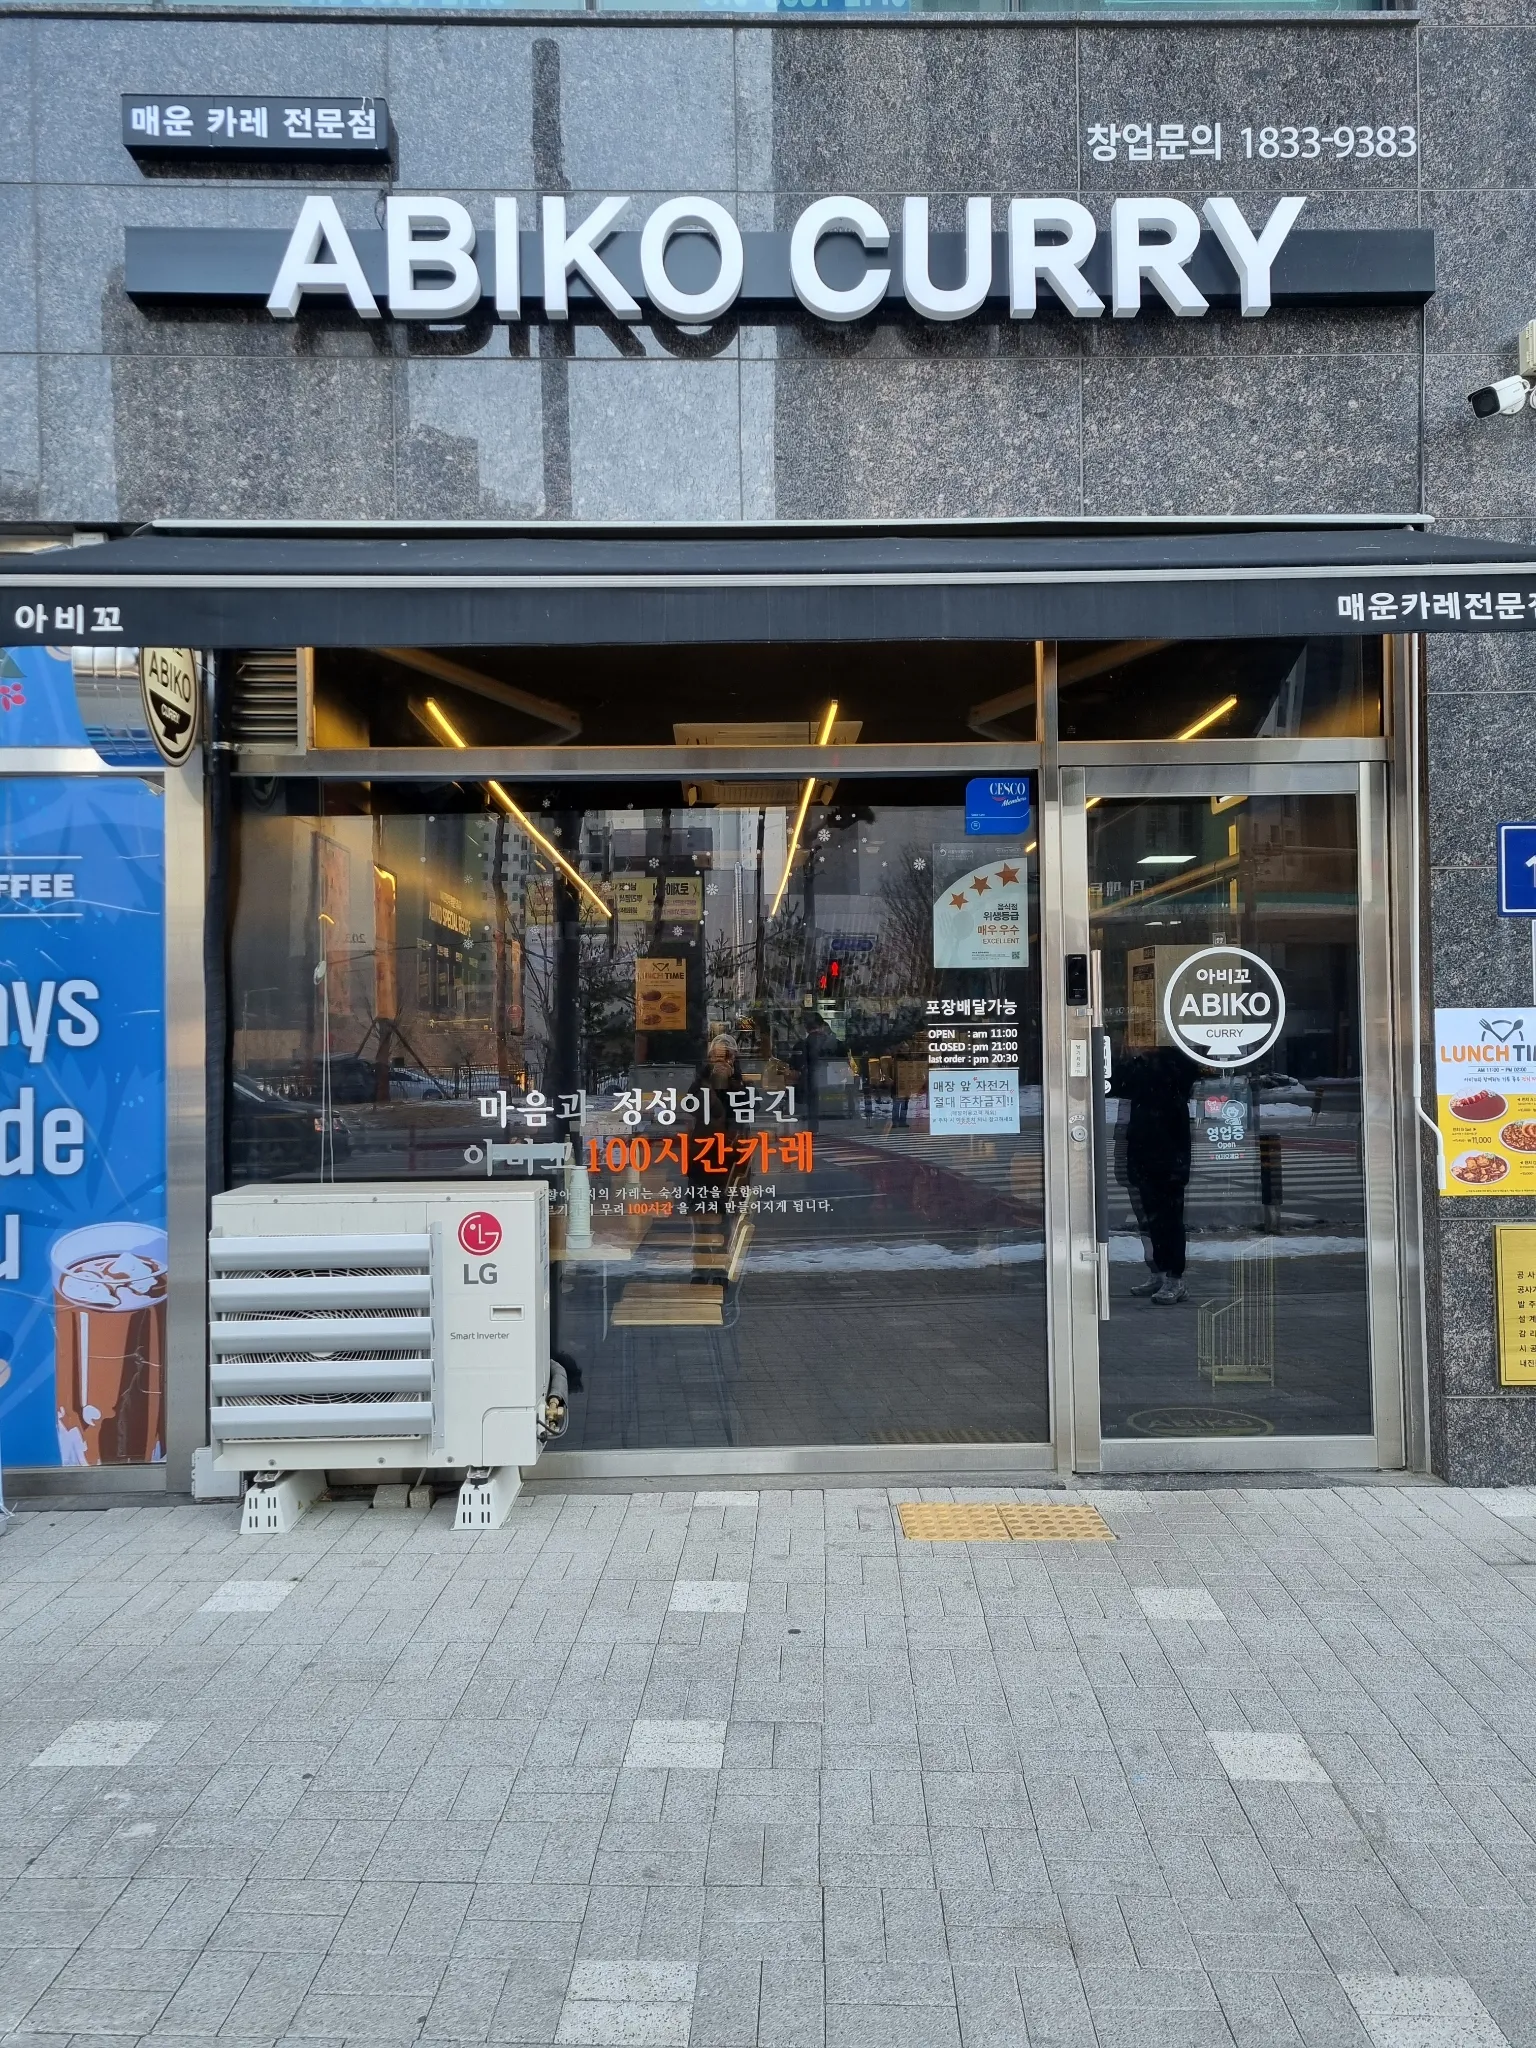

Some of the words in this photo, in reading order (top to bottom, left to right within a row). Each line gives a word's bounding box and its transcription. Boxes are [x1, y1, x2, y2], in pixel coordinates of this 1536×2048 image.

[131, 105, 194, 137] 매운
[207, 106, 268, 138] 카레
[283, 107, 376, 140] 전문점
[1086, 122, 1221, 161] 창업문의
[1240, 125, 1417, 159] 1833-9383
[265, 194, 745, 325] ABIKO
[789, 194, 1307, 322] CURRY
[14, 603, 124, 635] 아비꼬
[149, 650, 192, 703] ABIKO
[989, 782, 1026, 795] CESCO
[983, 911, 1020, 921] 위생등급
[977, 924, 998, 936] 매우
[999, 924, 1020, 936] 우수
[664, 972, 685, 980] TIME
[1196, 968, 1252, 985] 아비꼬
[925, 998, 1018, 1016] 포장배달가능
[1179, 991, 1271, 1017] ABIKO
[0, 979, 100, 1063] ys
[928, 1029, 956, 1039] OPEN
[990, 1028, 1018, 1038] 11:00
[1206, 1028, 1244, 1038] CURRY
[928, 1042, 966, 1052] CLOSED
[972, 1044, 989, 1053] pm
[991, 1041, 1018, 1051] 21:00
[1440, 1044, 1510, 1063] LUNCH
[1512, 1044, 1536, 1062] TI
[928, 1054, 943, 1064] last
[943, 1054, 966, 1063] order
[973, 1056, 989, 1066] pm
[991, 1053, 1019, 1063] 20:30
[933, 1080, 955, 1092] 매장
[960, 1080, 971, 1092] 앞
[976, 1079, 1009, 1092] 자전거
[477, 1089, 595, 1129] 마음과
[611, 1087, 711, 1126] 정성이
[726, 1086, 799, 1124] 담긴
[933, 1096, 956, 1109] 절대
[1207, 1125, 1245, 1142] 영업중
[586, 1130, 814, 1175] 100시간카레
[1217, 1141, 1237, 1149] Open
[615, 1187, 653, 1200] 카레는
[659, 1186, 722, 1200] 숙성시간을
[726, 1185, 776, 1198] 포함하여
[600, 1203, 624, 1216] 무려
[627, 1202, 673, 1216] 100시간
[677, 1202, 690, 1215] 을
[694, 1200, 718, 1214] 거쳐
[725, 1200, 787, 1214] 만들어지게
[793, 1199, 834, 1214] 됩니다.
[463, 1262, 498, 1285] LG
[450, 1332, 475, 1341] Smart
[476, 1332, 510, 1340] Inverter
[1520, 1359, 1536, 1368] 내진
